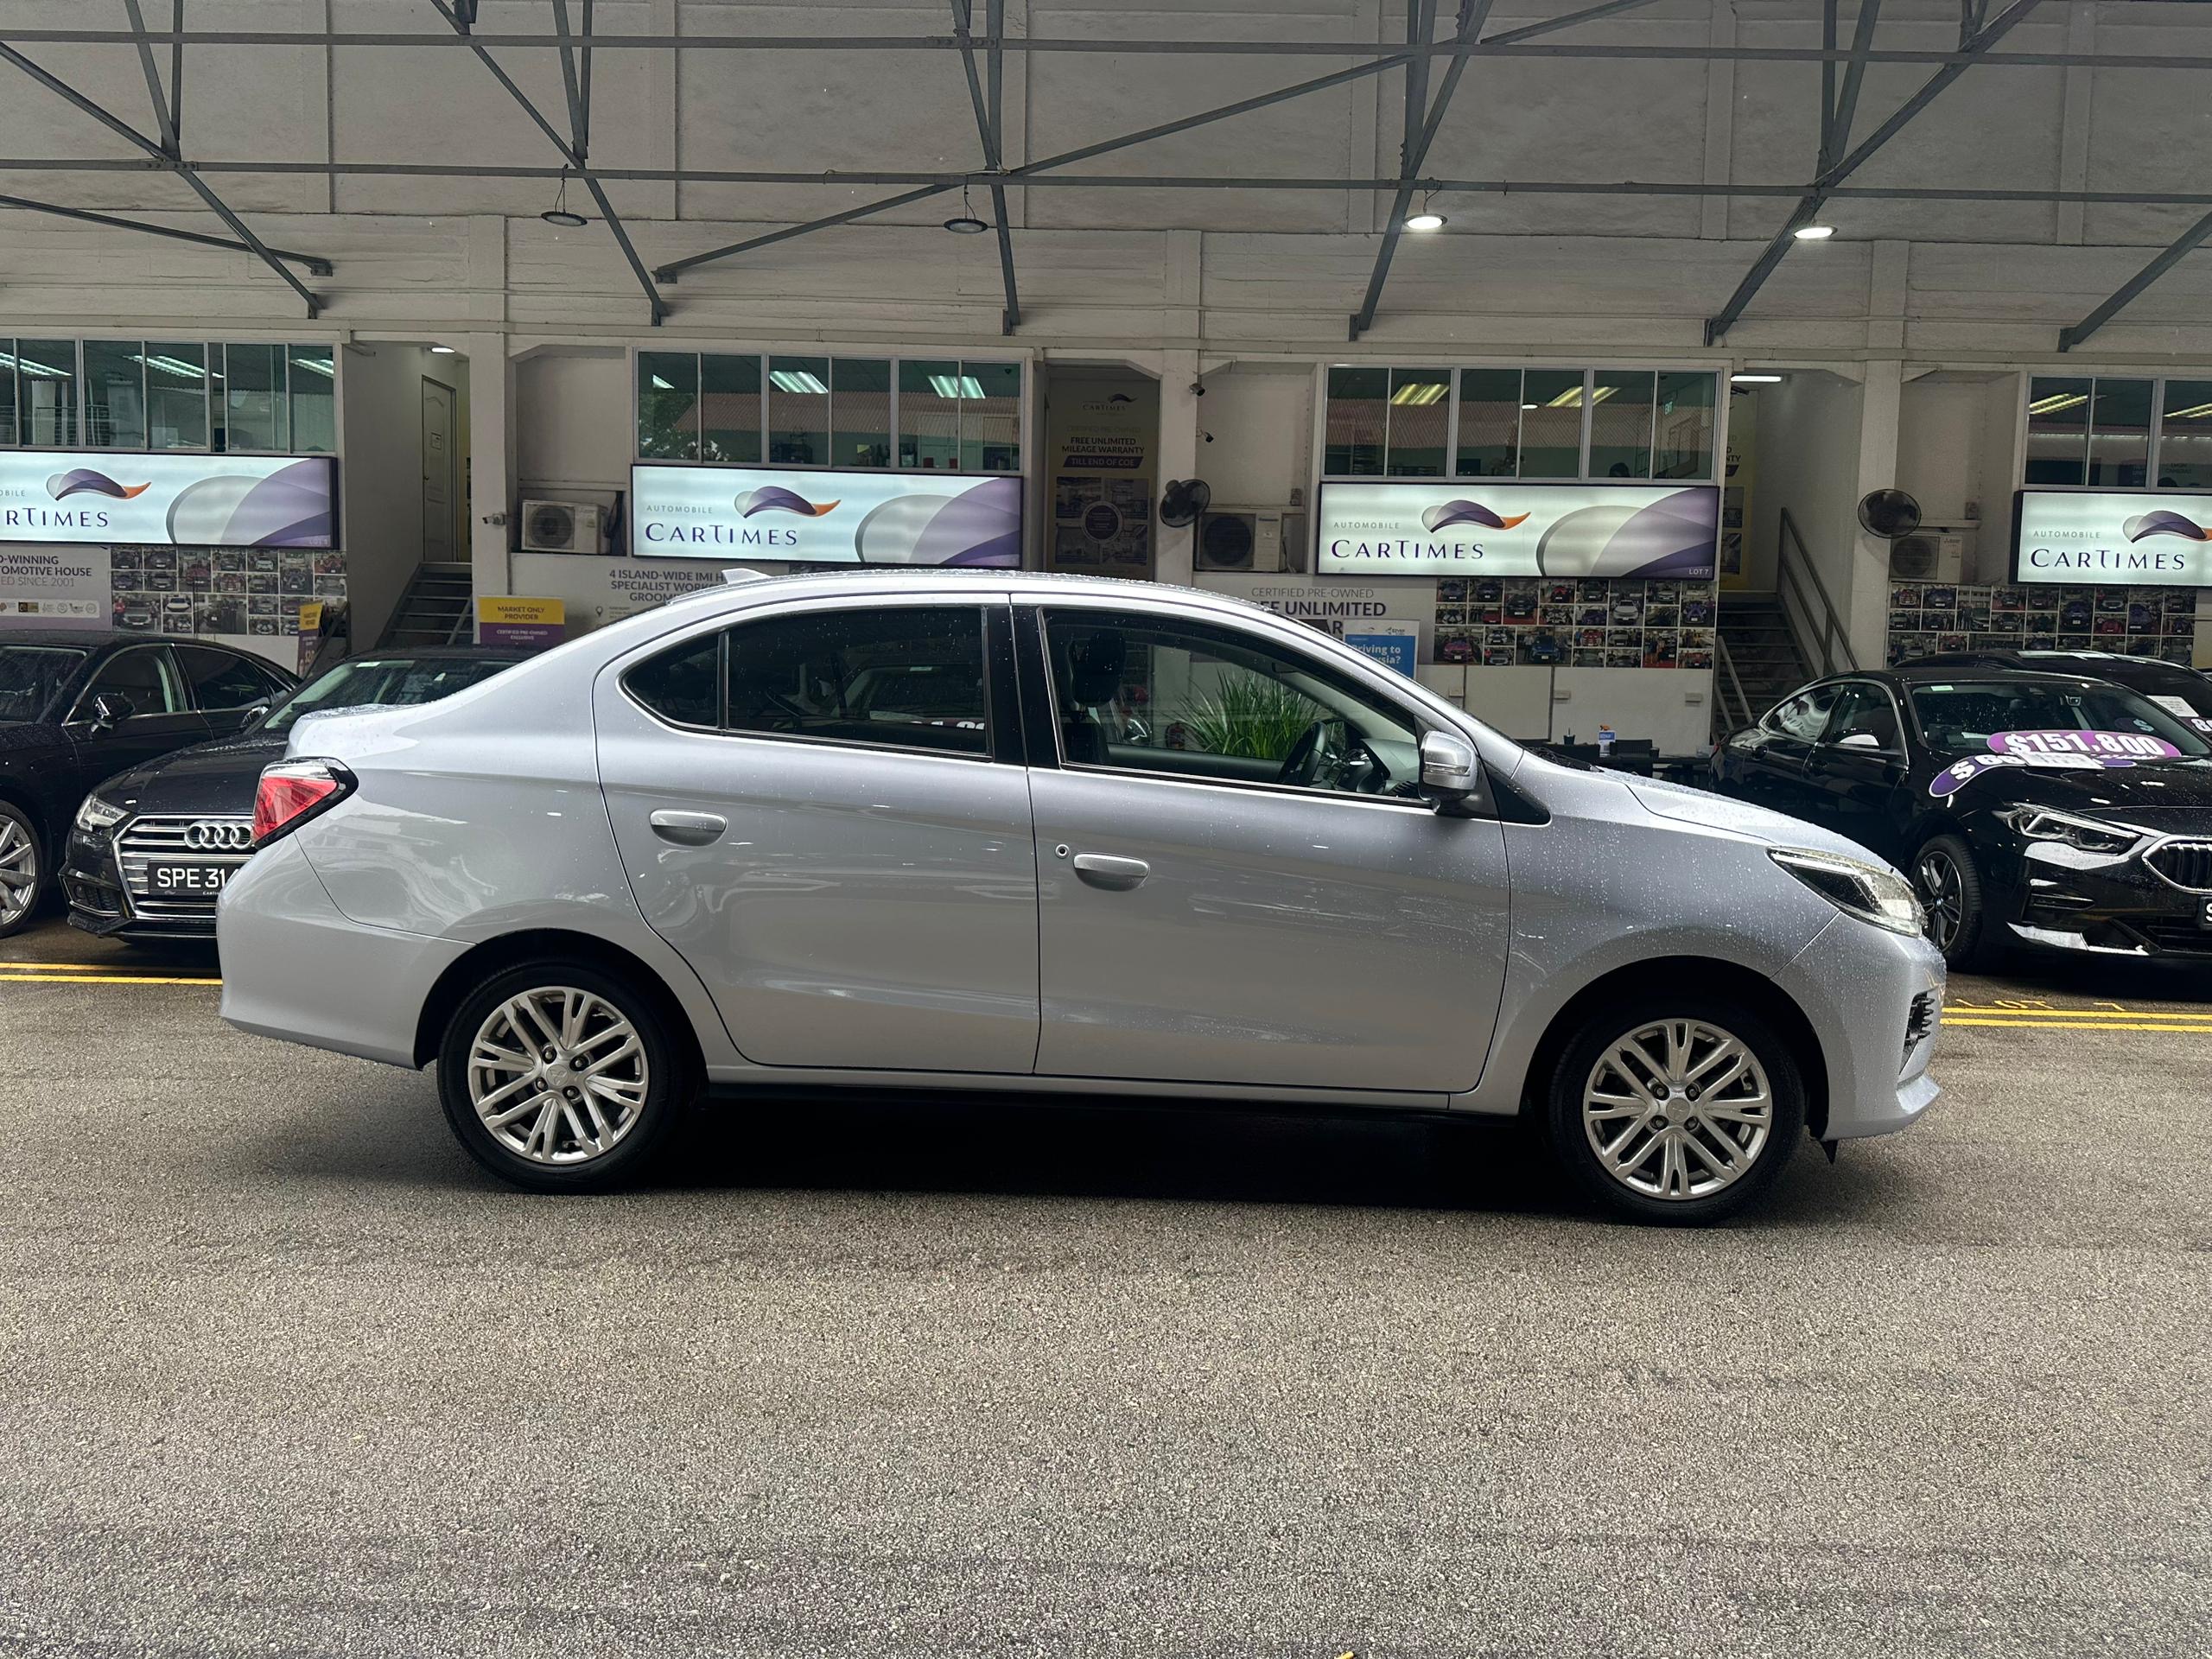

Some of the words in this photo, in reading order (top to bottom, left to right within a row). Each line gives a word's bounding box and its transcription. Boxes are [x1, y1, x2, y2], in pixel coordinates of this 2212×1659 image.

[1098, 446, 1145, 454] WARRANTY
[646, 505, 713, 514] AUTOMOBILE
[1333, 521, 1401, 530] AUTOMOBILE
[2033, 531, 2101, 539] AUTOMOBILE
[55, 567, 92, 576] HOUSE
[609, 569, 616, 578] 4
[619, 570, 693, 581] ISLAND-WIDE
[696, 572, 713, 582] IMI
[18, 576, 48, 587] SINCE
[51, 577, 74, 587] 2001
[611, 581, 671, 591] SPECIALIST
[1251, 587, 1305, 597] CERTIFIED
[1308, 588, 1374, 599] PRE-OWNED
[1285, 601, 1387, 617] UNLIMITED
[1390, 645, 1402, 654] to
[2005, 732, 2165, 756] $151,800
[156, 868, 201, 888] SPE
